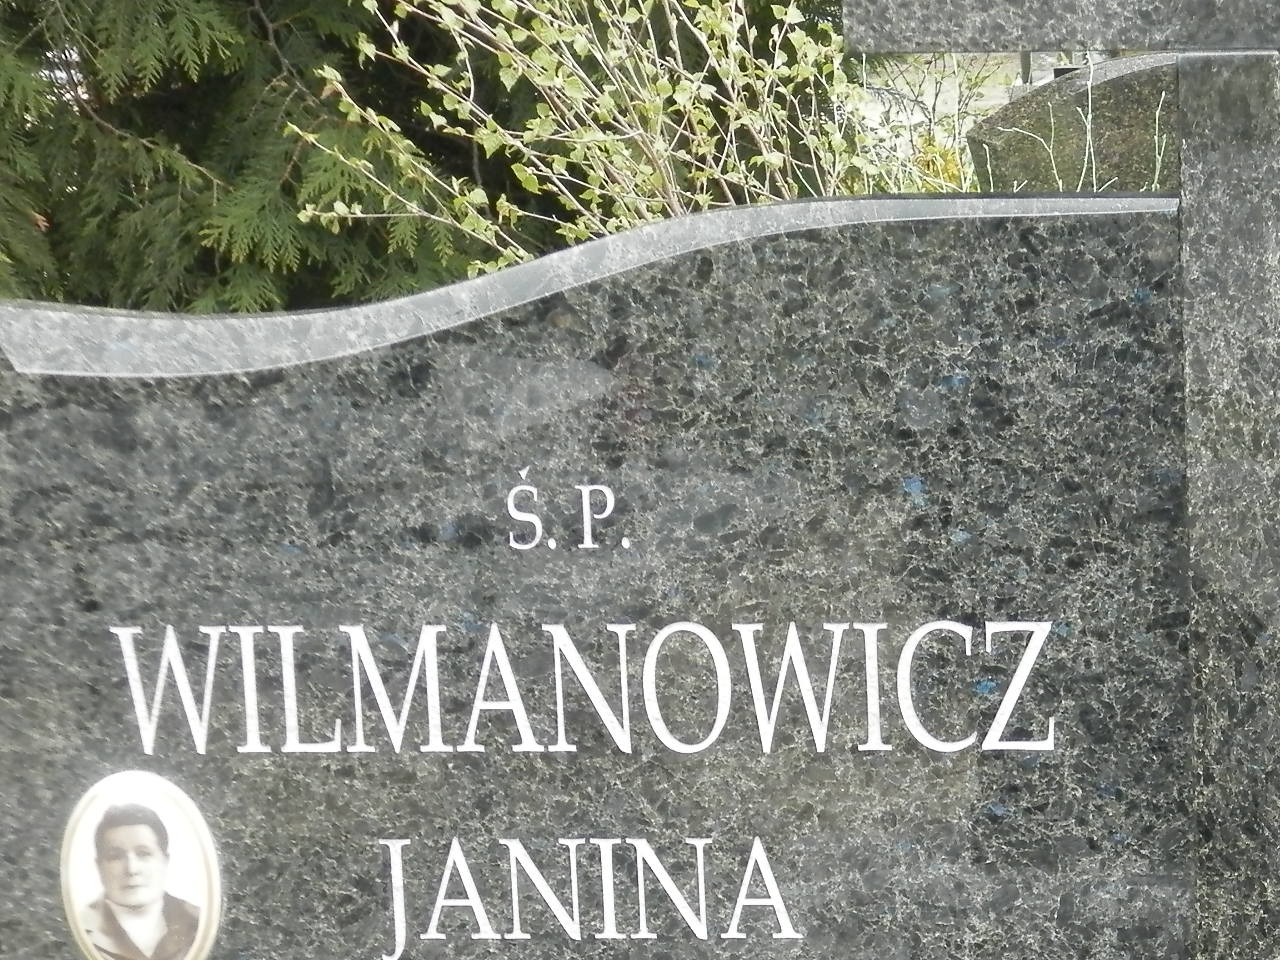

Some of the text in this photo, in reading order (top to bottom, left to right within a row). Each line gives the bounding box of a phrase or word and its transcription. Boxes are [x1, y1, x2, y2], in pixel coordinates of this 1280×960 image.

[506, 466, 631, 551] Ś. P.
[109, 619, 1057, 756] WILMANOWICZ
